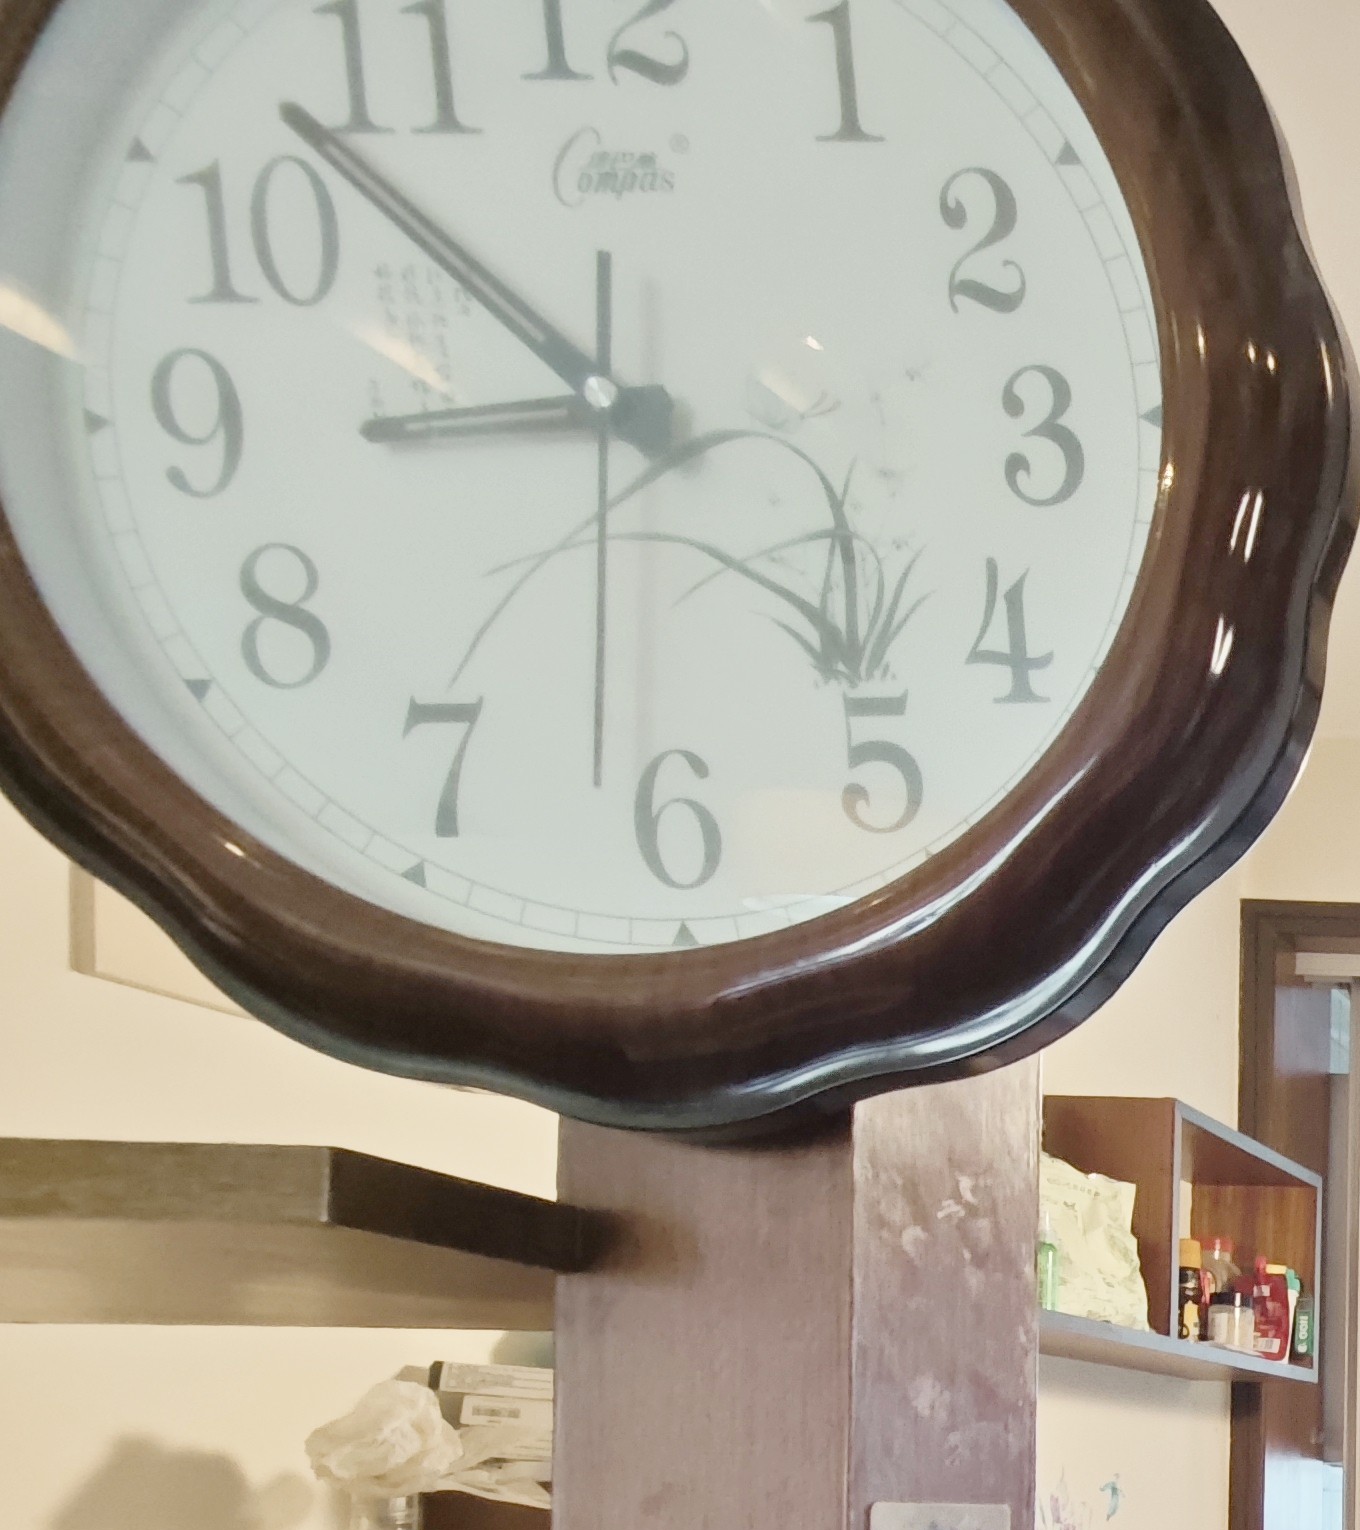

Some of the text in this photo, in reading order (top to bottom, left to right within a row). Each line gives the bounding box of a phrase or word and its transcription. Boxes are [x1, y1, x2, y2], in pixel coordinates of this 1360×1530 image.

[312, 0, 484, 135] 11
[804, 0, 886, 142] 1
[174, 155, 340, 306] 10
[938, 166, 1027, 315] 2
[150, 347, 243, 499] 9
[1001, 364, 1086, 507] 3
[239, 542, 331, 690] 8
[964, 556, 1055, 704] 4
[402, 695, 484, 838] 7
[634, 749, 722, 890] 6
[841, 688, 923, 834] 5
